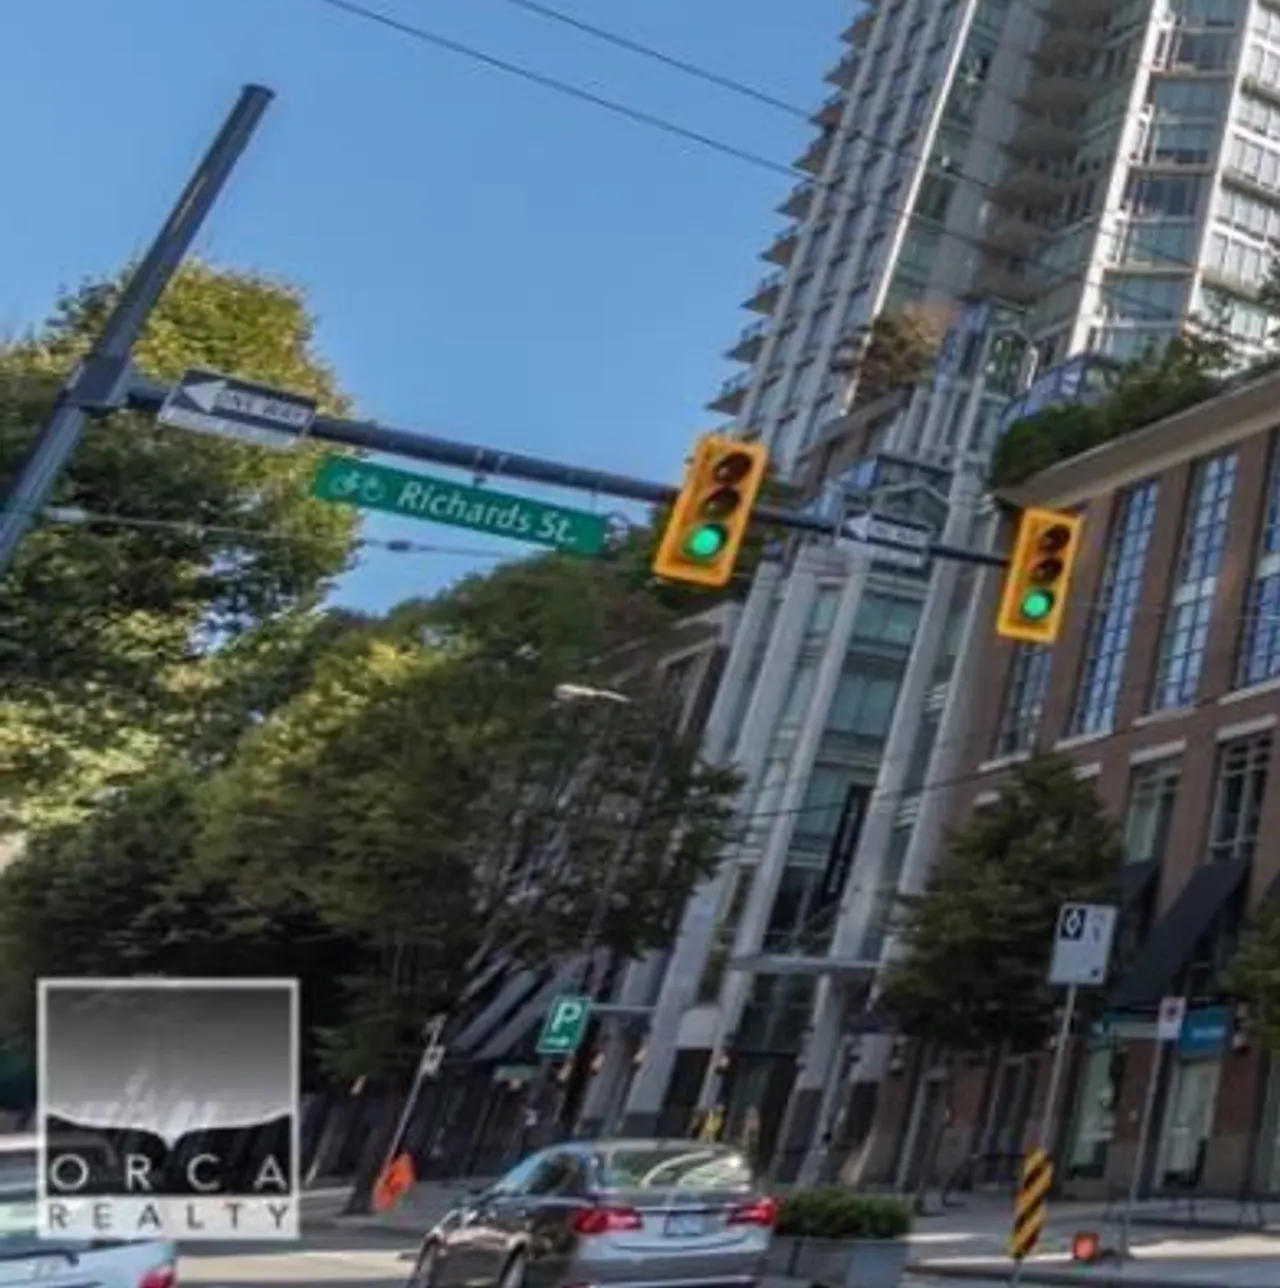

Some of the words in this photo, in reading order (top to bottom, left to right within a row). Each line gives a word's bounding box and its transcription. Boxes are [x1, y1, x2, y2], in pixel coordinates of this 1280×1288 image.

[398, 480, 531, 534] Richards
[535, 511, 578, 544] St.
[552, 1001, 582, 1032] P
